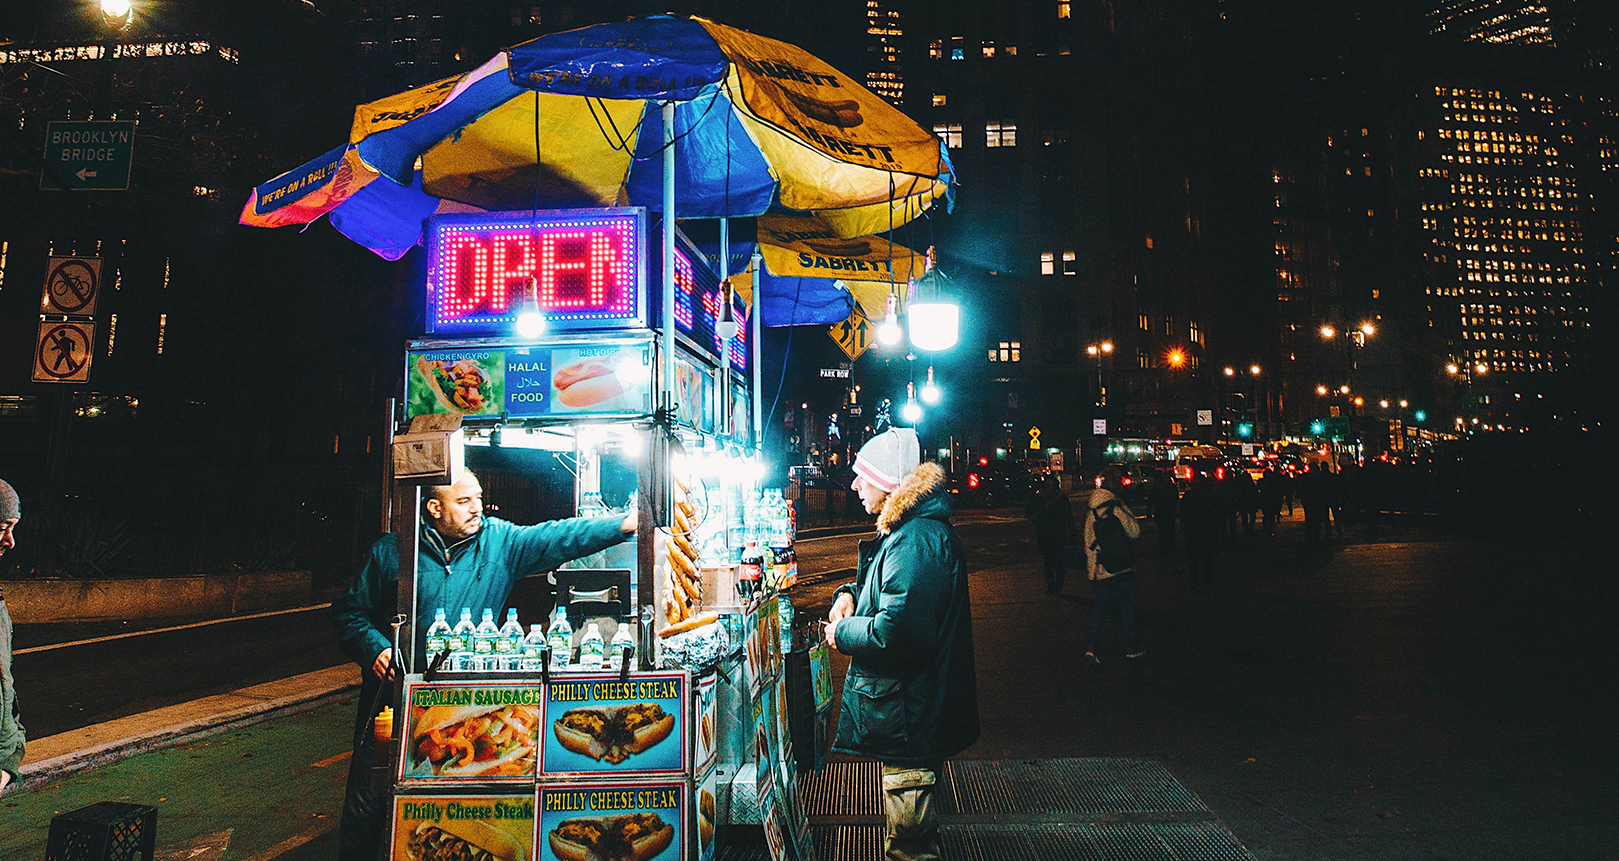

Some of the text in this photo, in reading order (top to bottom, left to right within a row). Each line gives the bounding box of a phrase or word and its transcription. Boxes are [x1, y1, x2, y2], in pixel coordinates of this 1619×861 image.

[588, 74, 613, 88] ON
[619, 75, 630, 89] A
[636, 76, 677, 91] ROLL
[52, 130, 129, 144] BROOKLYN
[61, 148, 115, 161] BRIDGE
[261, 187, 286, 206] WE'RE
[287, 180, 299, 194] ON
[300, 177, 306, 188] A
[307, 167, 326, 185] ROLL
[444, 229, 631, 317] OPEN
[424, 352, 490, 362] CHICKEN GYRO
[579, 347, 621, 357] HOT DOG
[508, 362, 547, 373] HALAL
[820, 369, 850, 379] PARK ROW
[516, 376, 541, 389] حلال
[511, 393, 544, 403] FOOD
[414, 688, 541, 706] ITALIAN SAUSAGE
[549, 680, 678, 702] PHILLY CHEESE STEAK
[545, 790, 678, 811] PHILLY CHEESE STEAK
[403, 802, 534, 824] Philly Cheese Steak
